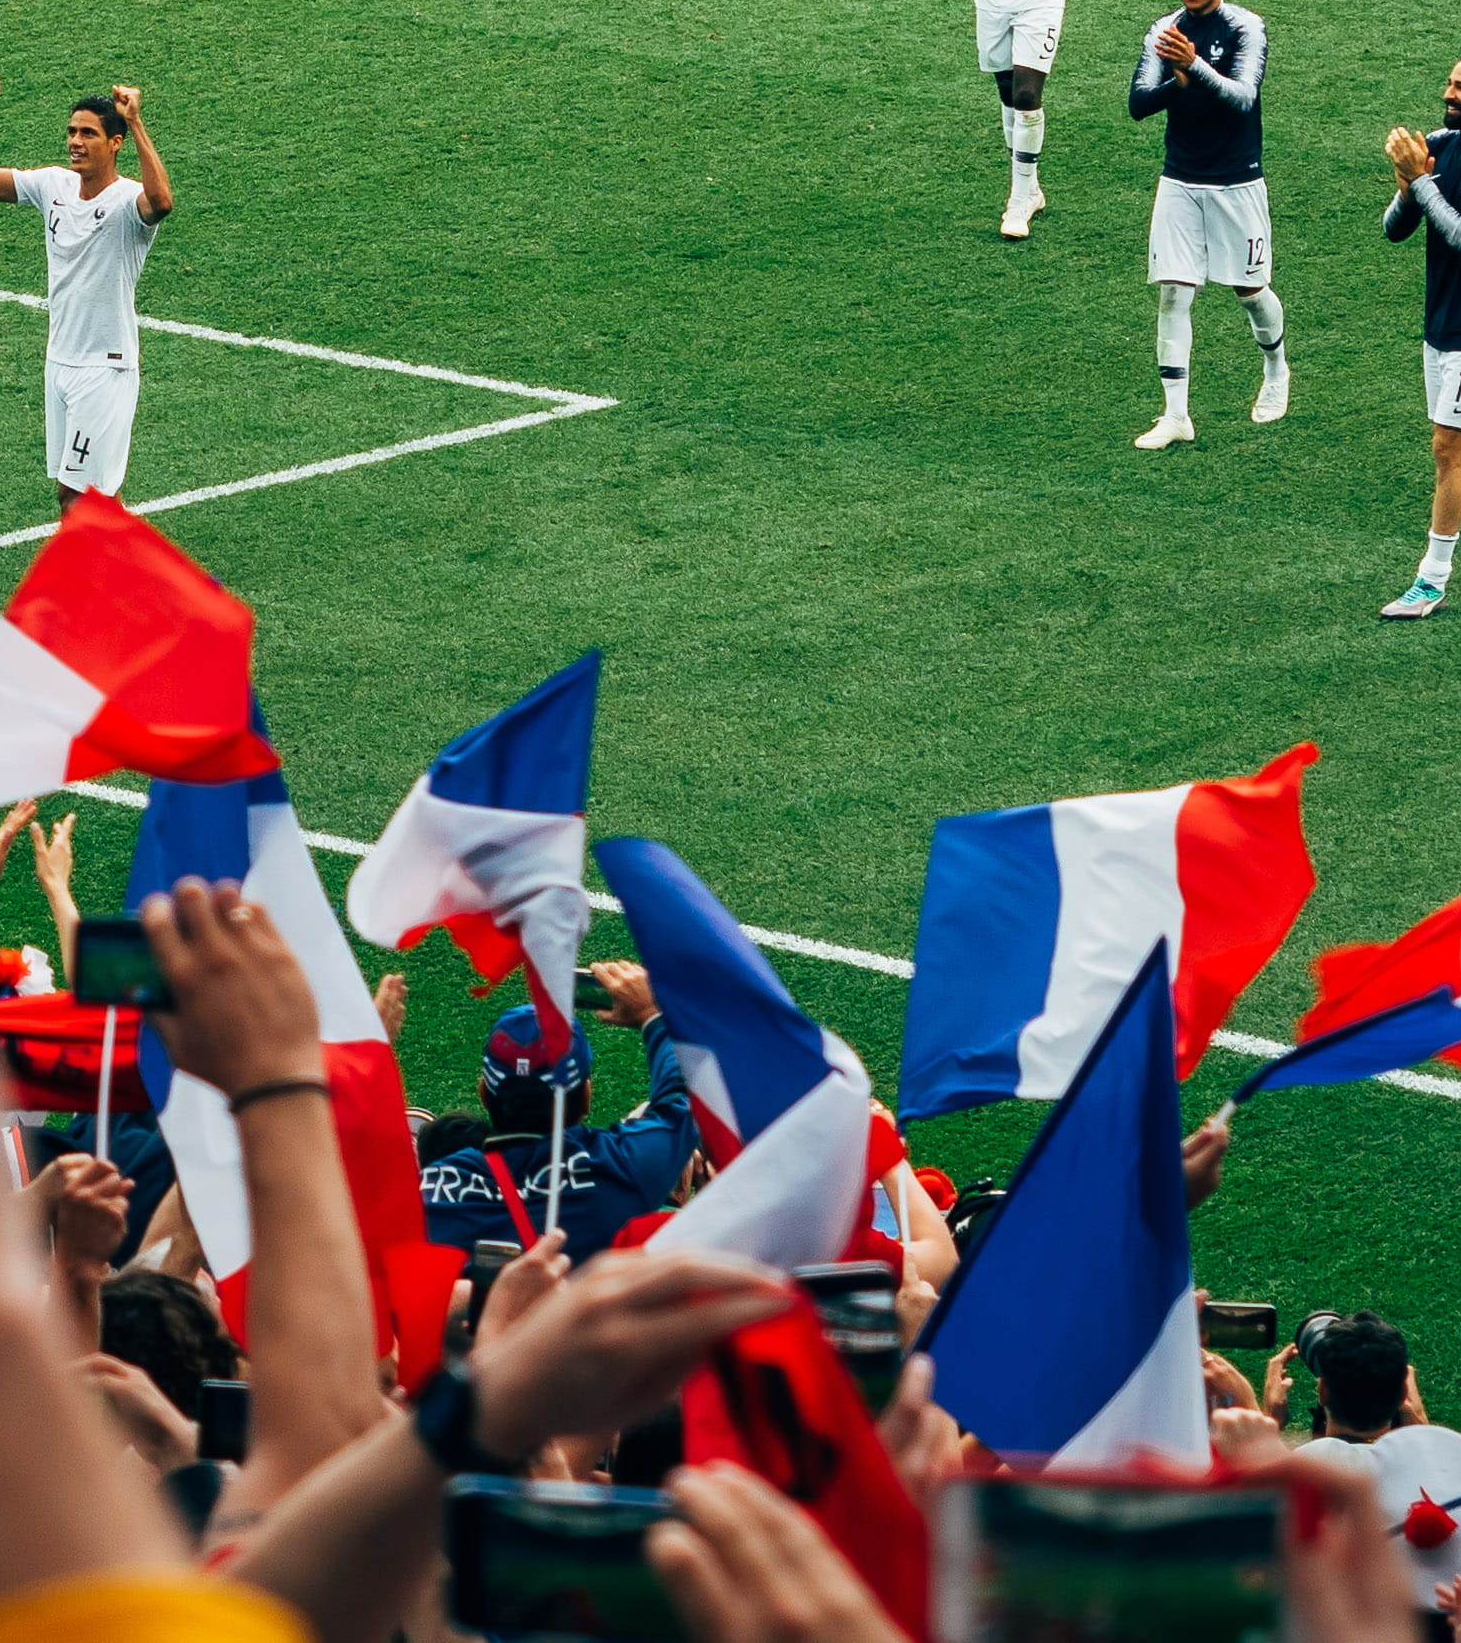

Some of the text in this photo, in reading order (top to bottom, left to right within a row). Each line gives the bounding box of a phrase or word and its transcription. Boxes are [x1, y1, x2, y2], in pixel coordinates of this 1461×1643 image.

[1044, 27, 1056, 53] 5
[49, 209, 60, 243] 4
[1247, 237, 1265, 266] 12
[72, 430, 90, 465] 4
[419, 1151, 596, 1204] FRACE
